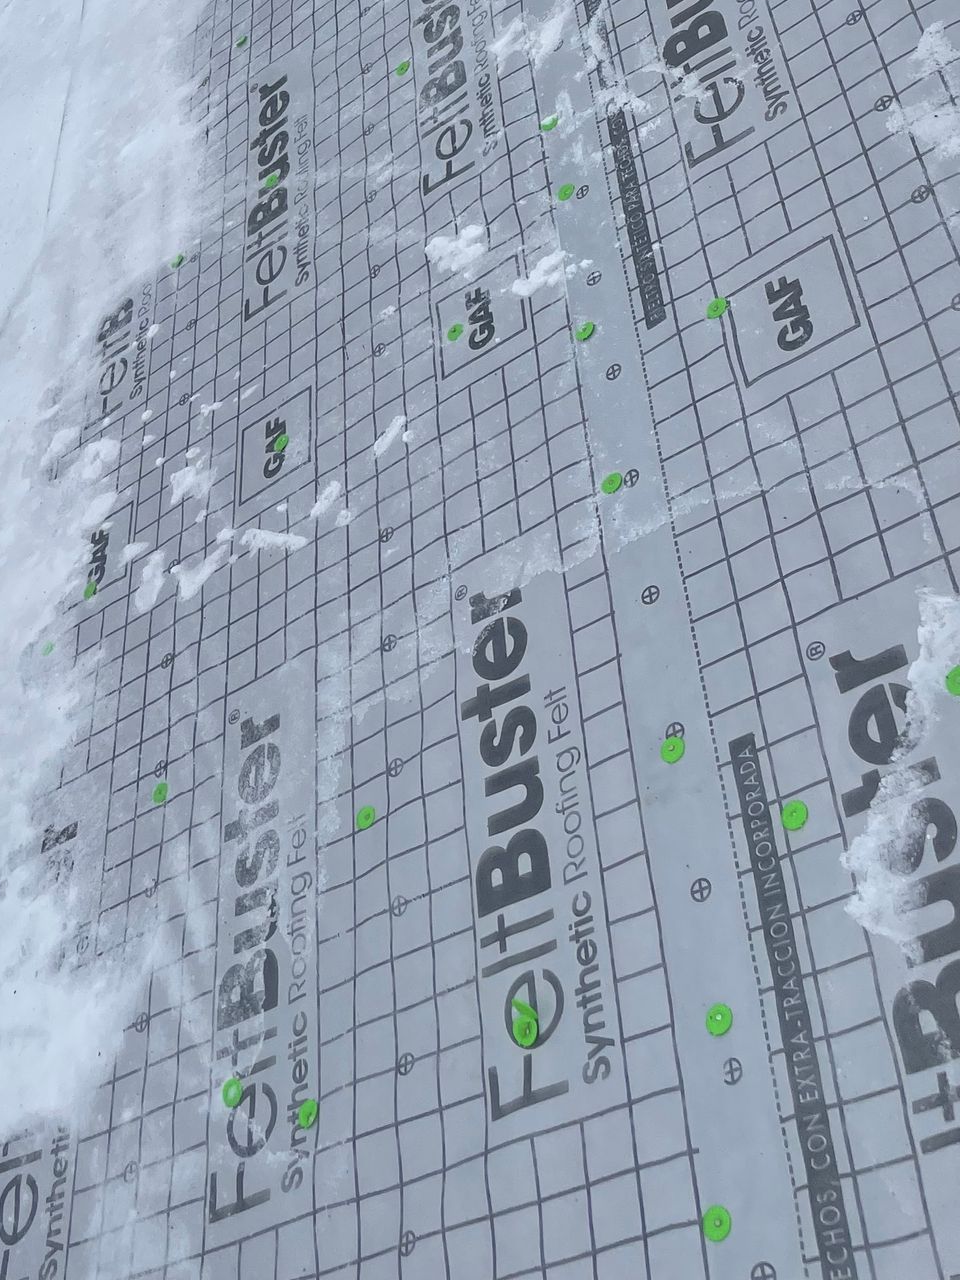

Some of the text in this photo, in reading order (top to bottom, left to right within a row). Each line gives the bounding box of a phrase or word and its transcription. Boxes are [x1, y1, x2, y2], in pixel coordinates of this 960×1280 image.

[293, 114, 308, 143] Felt
[475, 72, 501, 156] Synthetic
[744, 24, 789, 122] Synthetic
[243, 73, 288, 321] FeltBuster
[128, 317, 148, 400] Synthetic
[467, 286, 496, 352] GAF
[764, 276, 814, 351] GAF
[263, 417, 288, 480] GAF
[85, 528, 110, 586] GAF
[460, 586, 569, 1122] FeltBuster
[544, 686, 615, 1085] Synthetic Roofing Felt
[827, 643, 960, 1154] ltBuster
[209, 713, 282, 1225] FeltBuster
[285, 870, 312, 1004] Roofing
[737, 744, 851, 1280] ECHOS, CON EXTRA-TRACCION INCORPORADA
[37, 1126, 70, 1279] Syntheti
